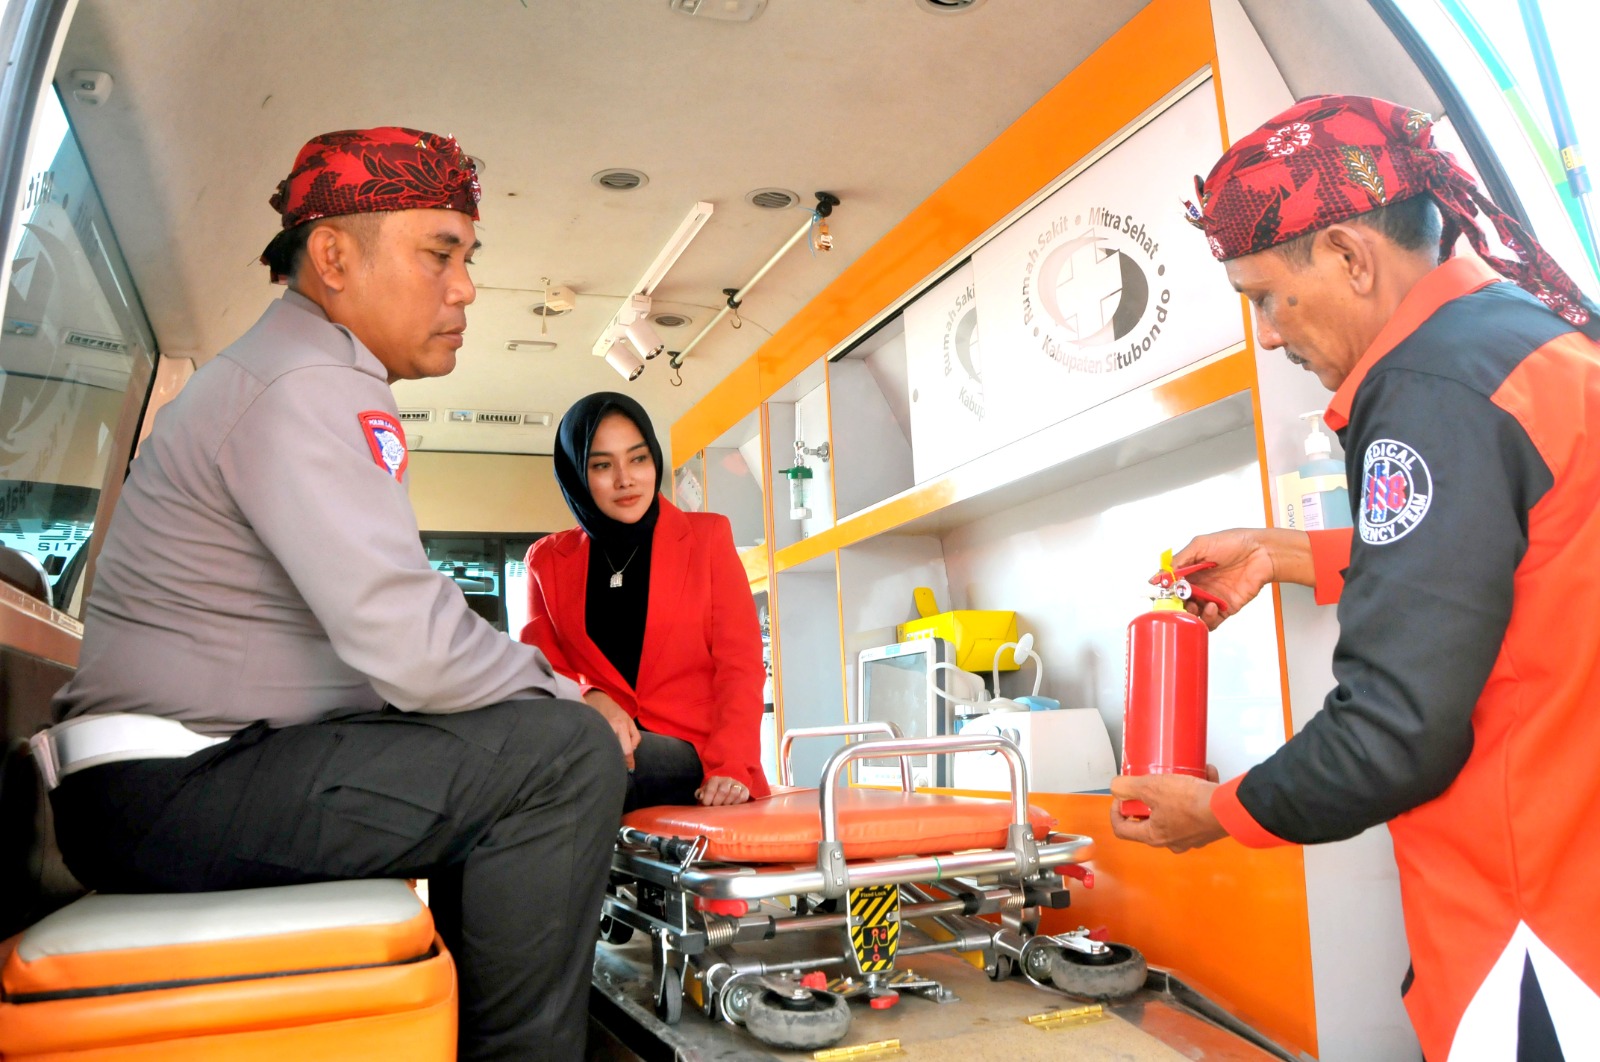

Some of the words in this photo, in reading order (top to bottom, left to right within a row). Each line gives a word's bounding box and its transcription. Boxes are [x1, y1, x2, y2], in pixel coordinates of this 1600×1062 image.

[1088, 207, 1121, 230] Mitra
[1122, 215, 1159, 260] Sehat
[1022, 249, 1039, 325] Rumah
[1038, 216, 1068, 250] Sakit
[943, 310, 956, 377] Rumah
[1042, 334, 1102, 374] Kabupaten
[1105, 289, 1170, 374] Situbondo
[1398, 493, 1428, 529] TEAM
